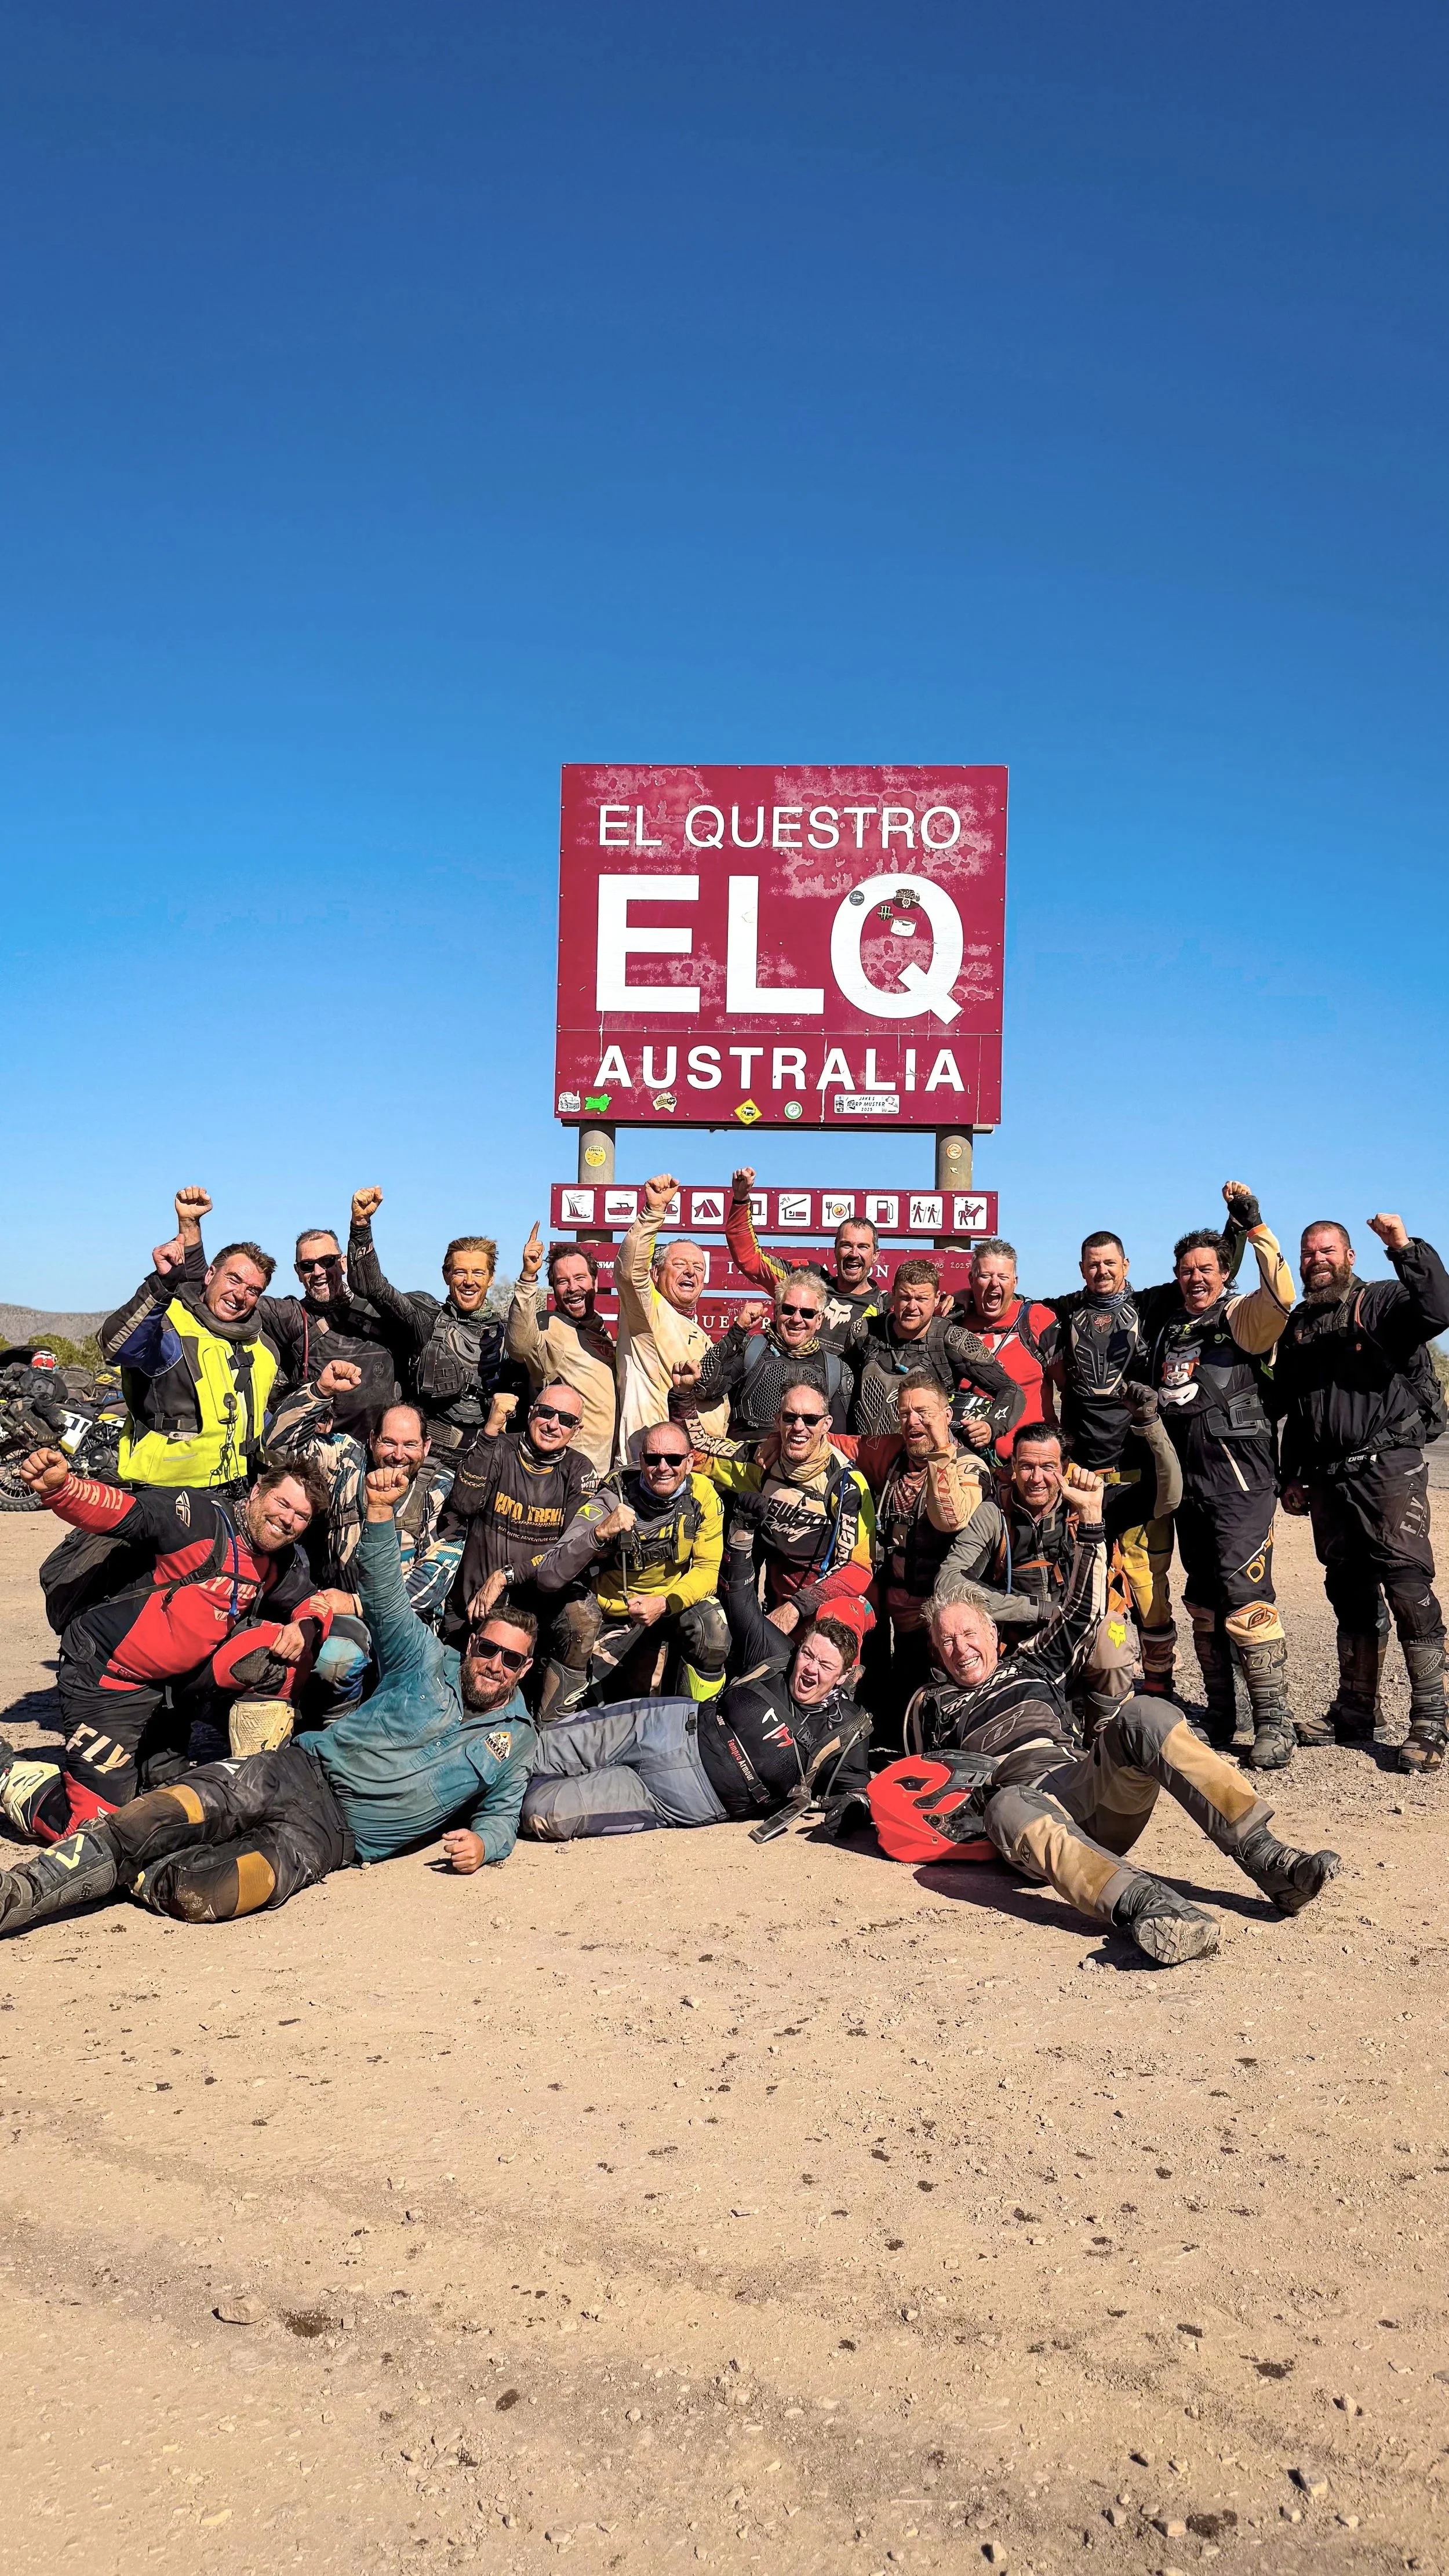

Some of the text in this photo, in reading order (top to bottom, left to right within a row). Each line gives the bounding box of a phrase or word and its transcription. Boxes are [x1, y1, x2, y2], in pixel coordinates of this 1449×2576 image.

[599, 805, 962, 850] EL QUESTRO
[596, 873, 964, 1025] ELQ
[594, 1045, 965, 1092] AUSTRALIA
[761, 1514, 821, 1543] Racing
[1399, 1496, 1425, 1535] FLY
[65, 1722, 132, 1774] FLY
[738, 1759, 754, 1781] Armour
